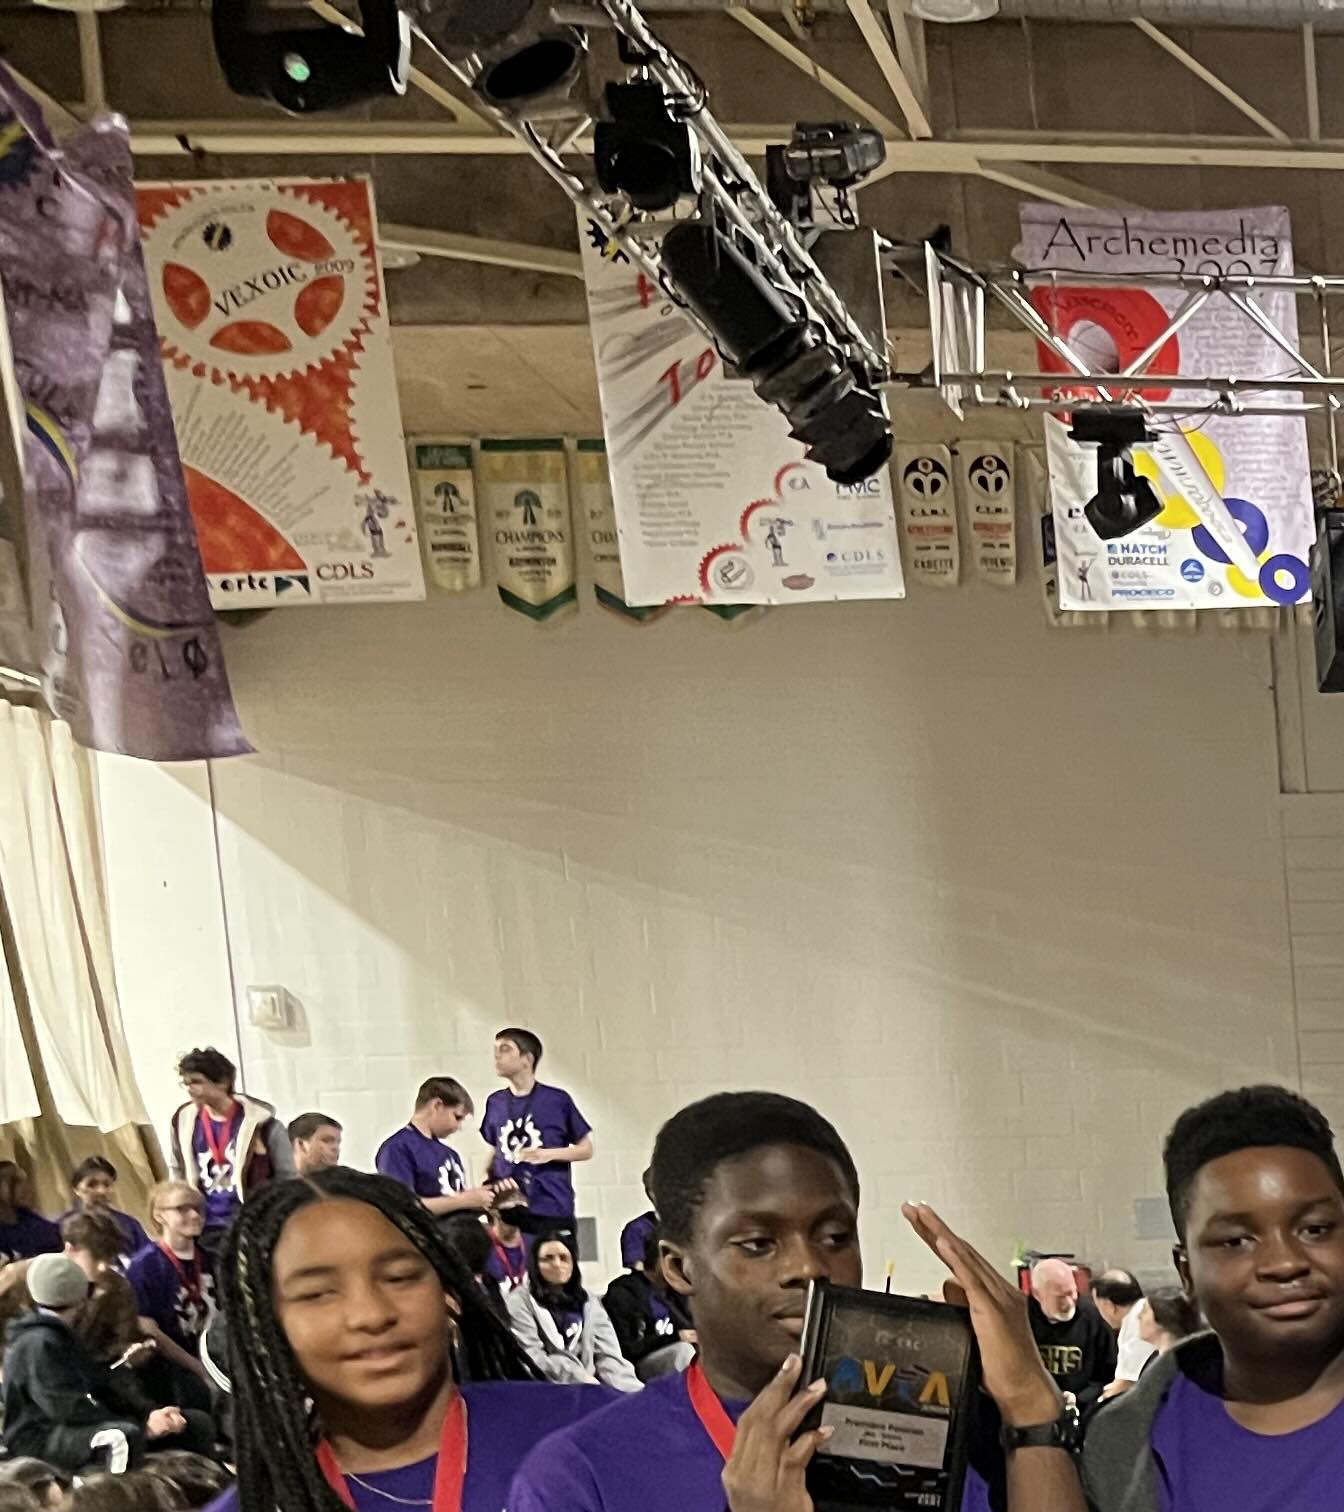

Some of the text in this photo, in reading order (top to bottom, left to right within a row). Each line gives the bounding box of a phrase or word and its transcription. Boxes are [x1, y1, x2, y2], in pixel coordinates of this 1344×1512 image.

[1042, 217, 1278, 262] Archemedia
[213, 260, 308, 317] VEXOIC
[1120, 543, 1168, 556] HATCH
[316, 561, 375, 582] CDLS
[1107, 556, 1170, 567] DURACELL
